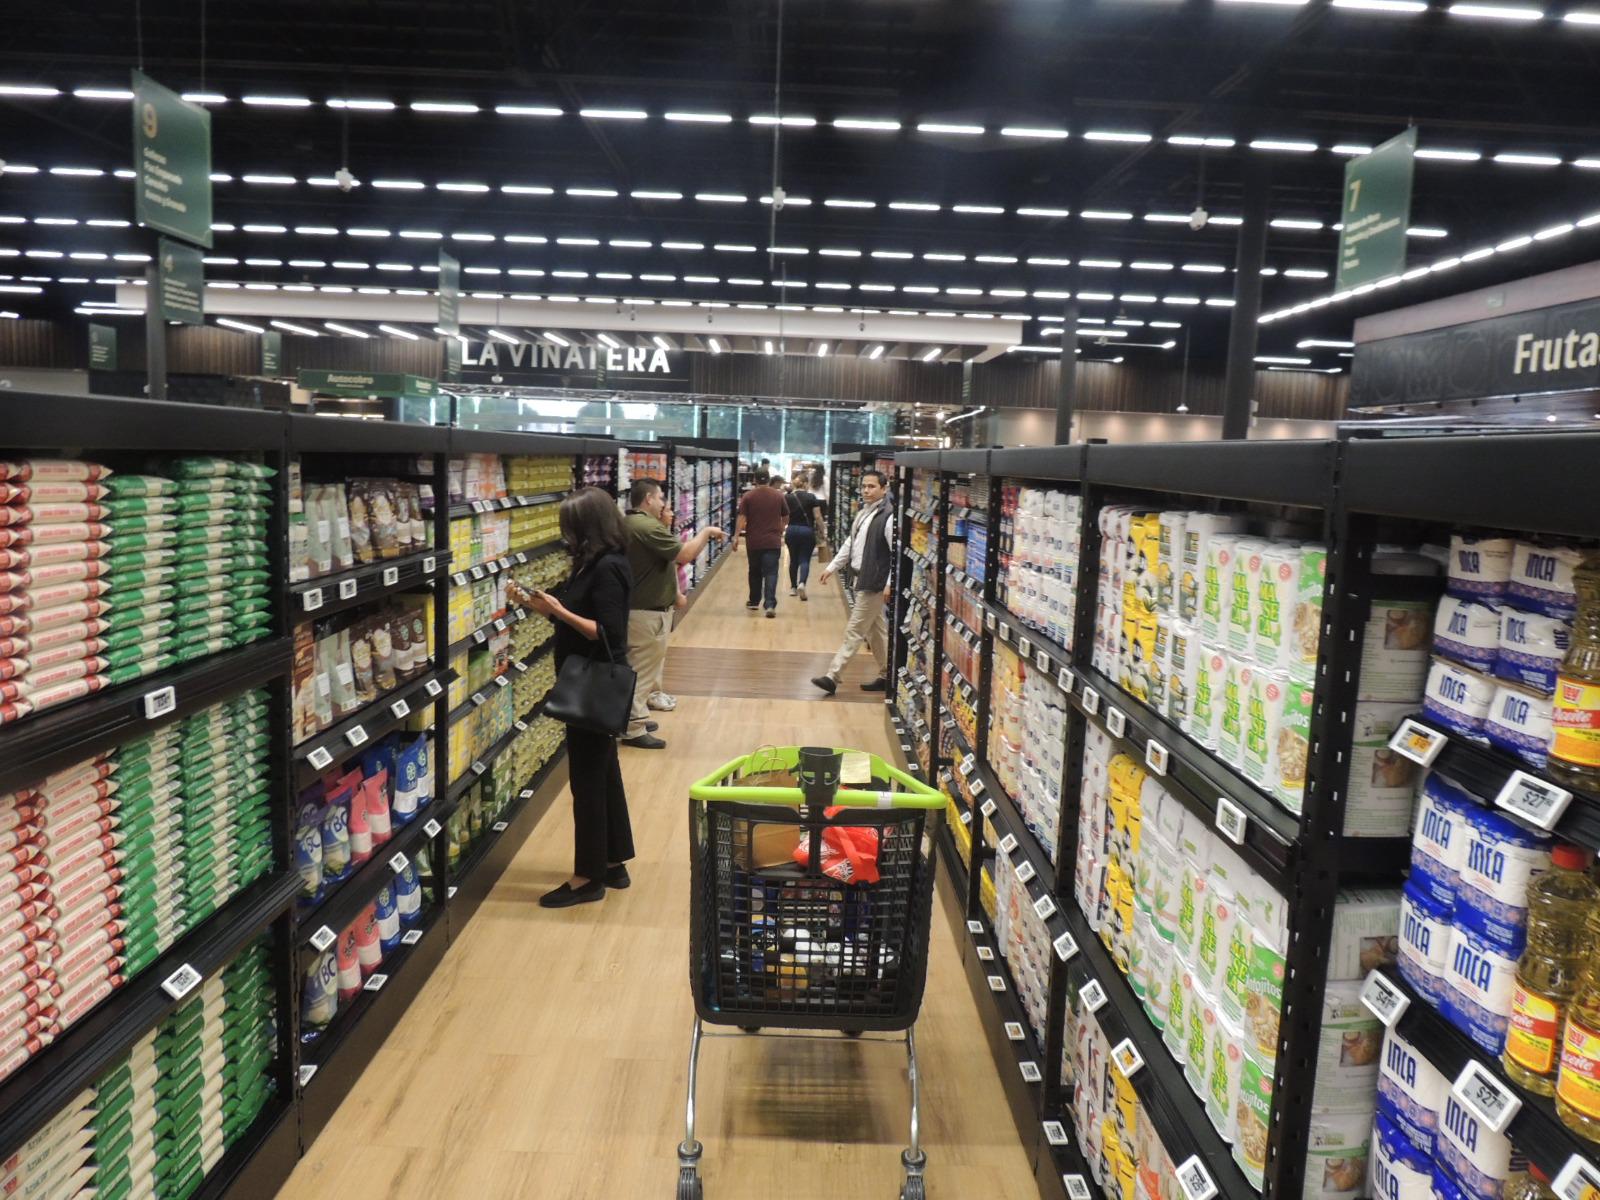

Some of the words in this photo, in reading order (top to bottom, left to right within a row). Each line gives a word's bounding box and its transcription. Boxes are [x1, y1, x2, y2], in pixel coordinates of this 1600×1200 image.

[461, 342, 498, 367] LA
[1525, 552, 1556, 582] INCA
[1439, 674, 1467, 705] INCA
[1501, 695, 1530, 725] INCA
[1422, 807, 1452, 850] INCA
[1468, 838, 1505, 884] INCA
[1403, 911, 1431, 957] INCA
[1453, 943, 1492, 993] INCA
[1387, 1038, 1417, 1090] INCA
[1444, 1095, 1478, 1153] INCA
